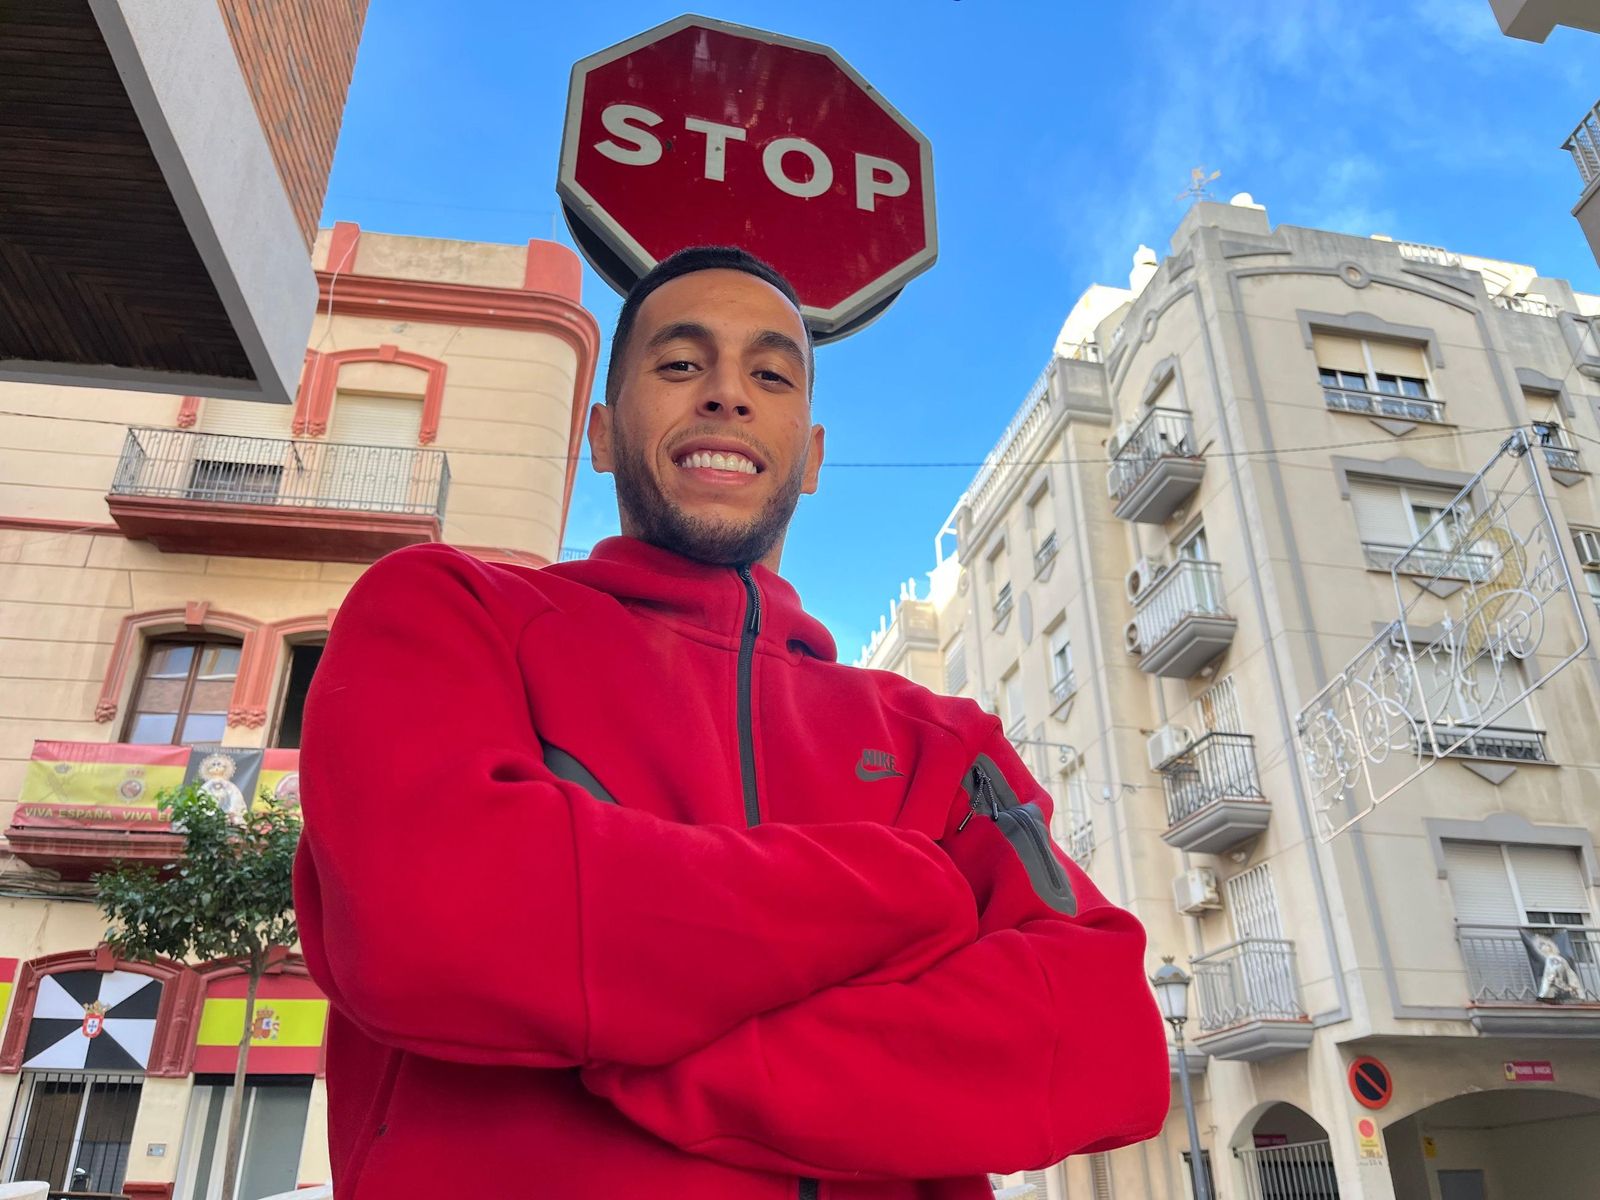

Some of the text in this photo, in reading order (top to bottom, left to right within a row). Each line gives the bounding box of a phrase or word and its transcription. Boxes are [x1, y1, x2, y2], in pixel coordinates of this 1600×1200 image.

[593, 104, 911, 212] STOP
[863, 749, 897, 769] NIKE
[25, 807, 53, 817] VIVA
[122, 810, 153, 821] VIVA
